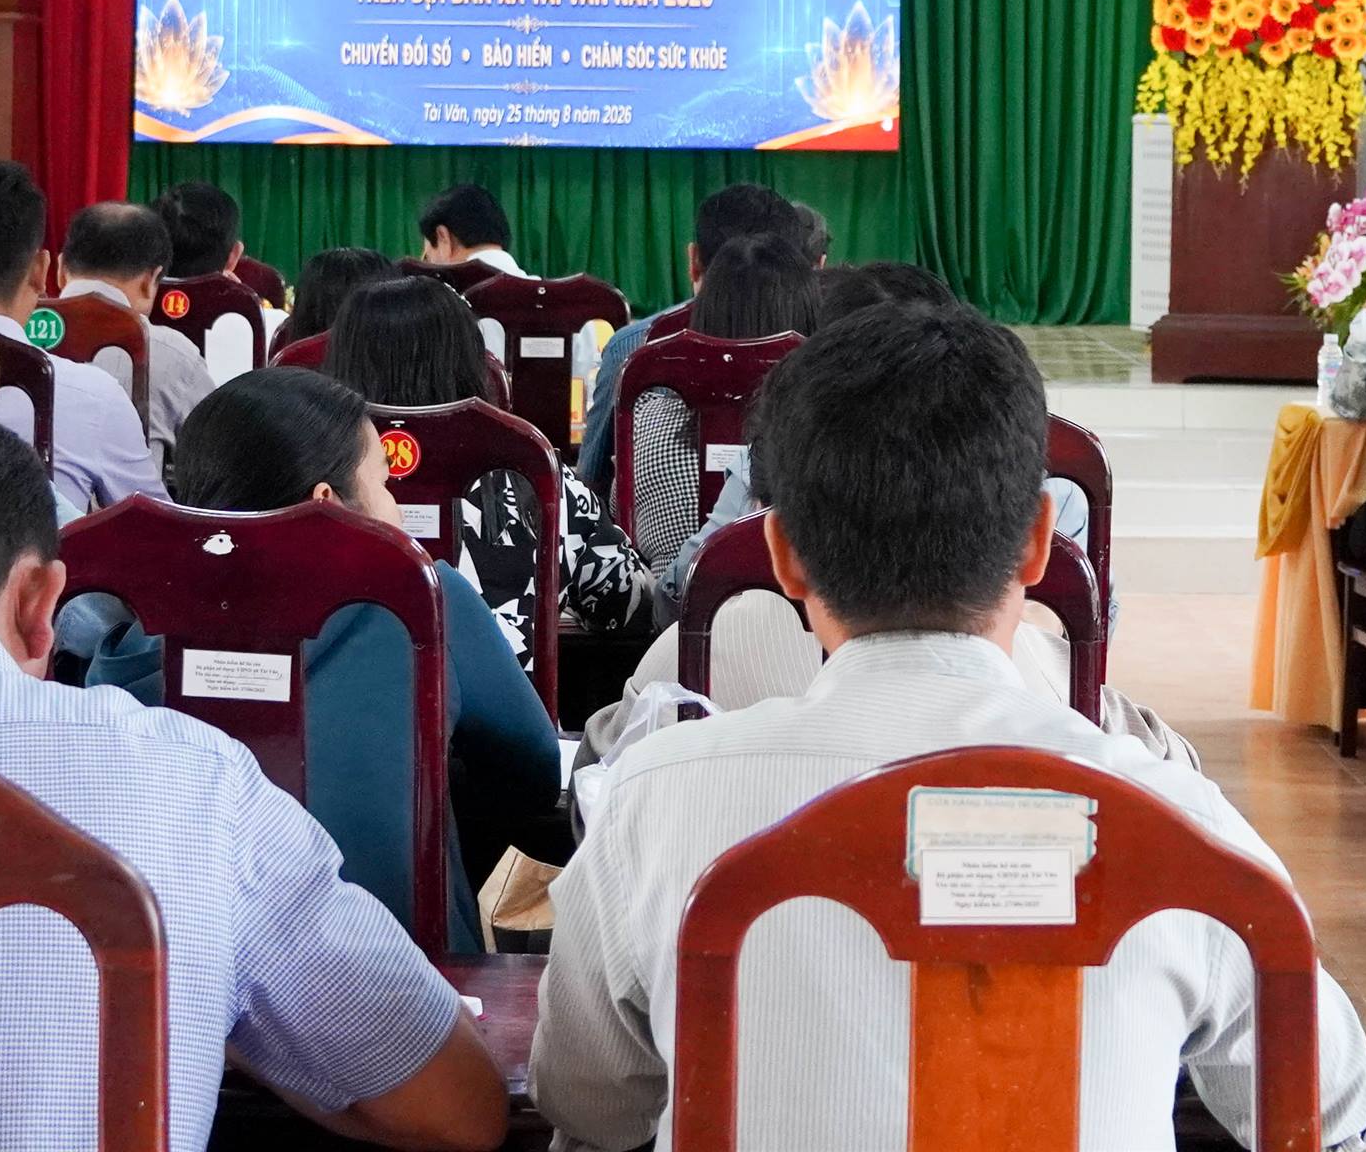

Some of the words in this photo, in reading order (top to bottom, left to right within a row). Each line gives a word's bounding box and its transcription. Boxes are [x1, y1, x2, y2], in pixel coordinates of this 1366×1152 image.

[341, 37, 398, 66] CHUYỂN
[403, 37, 427, 66] ĐỔI
[432, 37, 451, 66] SỐ
[482, 39, 513, 66] BẢO
[517, 37, 552, 67] HIỂM
[581, 43, 623, 69] CHĂM
[627, 43, 654, 69] SÓC
[658, 44, 687, 70] SỨC
[691, 42, 727, 70] KHỎE
[424, 103, 441, 121] Tài
[445, 104, 469, 123] Văn,
[474, 105, 504, 126] ngày
[507, 105, 522, 122] 25
[524, 105, 560, 126] tháng
[562, 107, 570, 122] 8
[574, 107, 601, 123] năm
[603, 107, 632, 124] 2026
[29, 319, 57, 339] 121
[383, 438, 414, 469] 28
